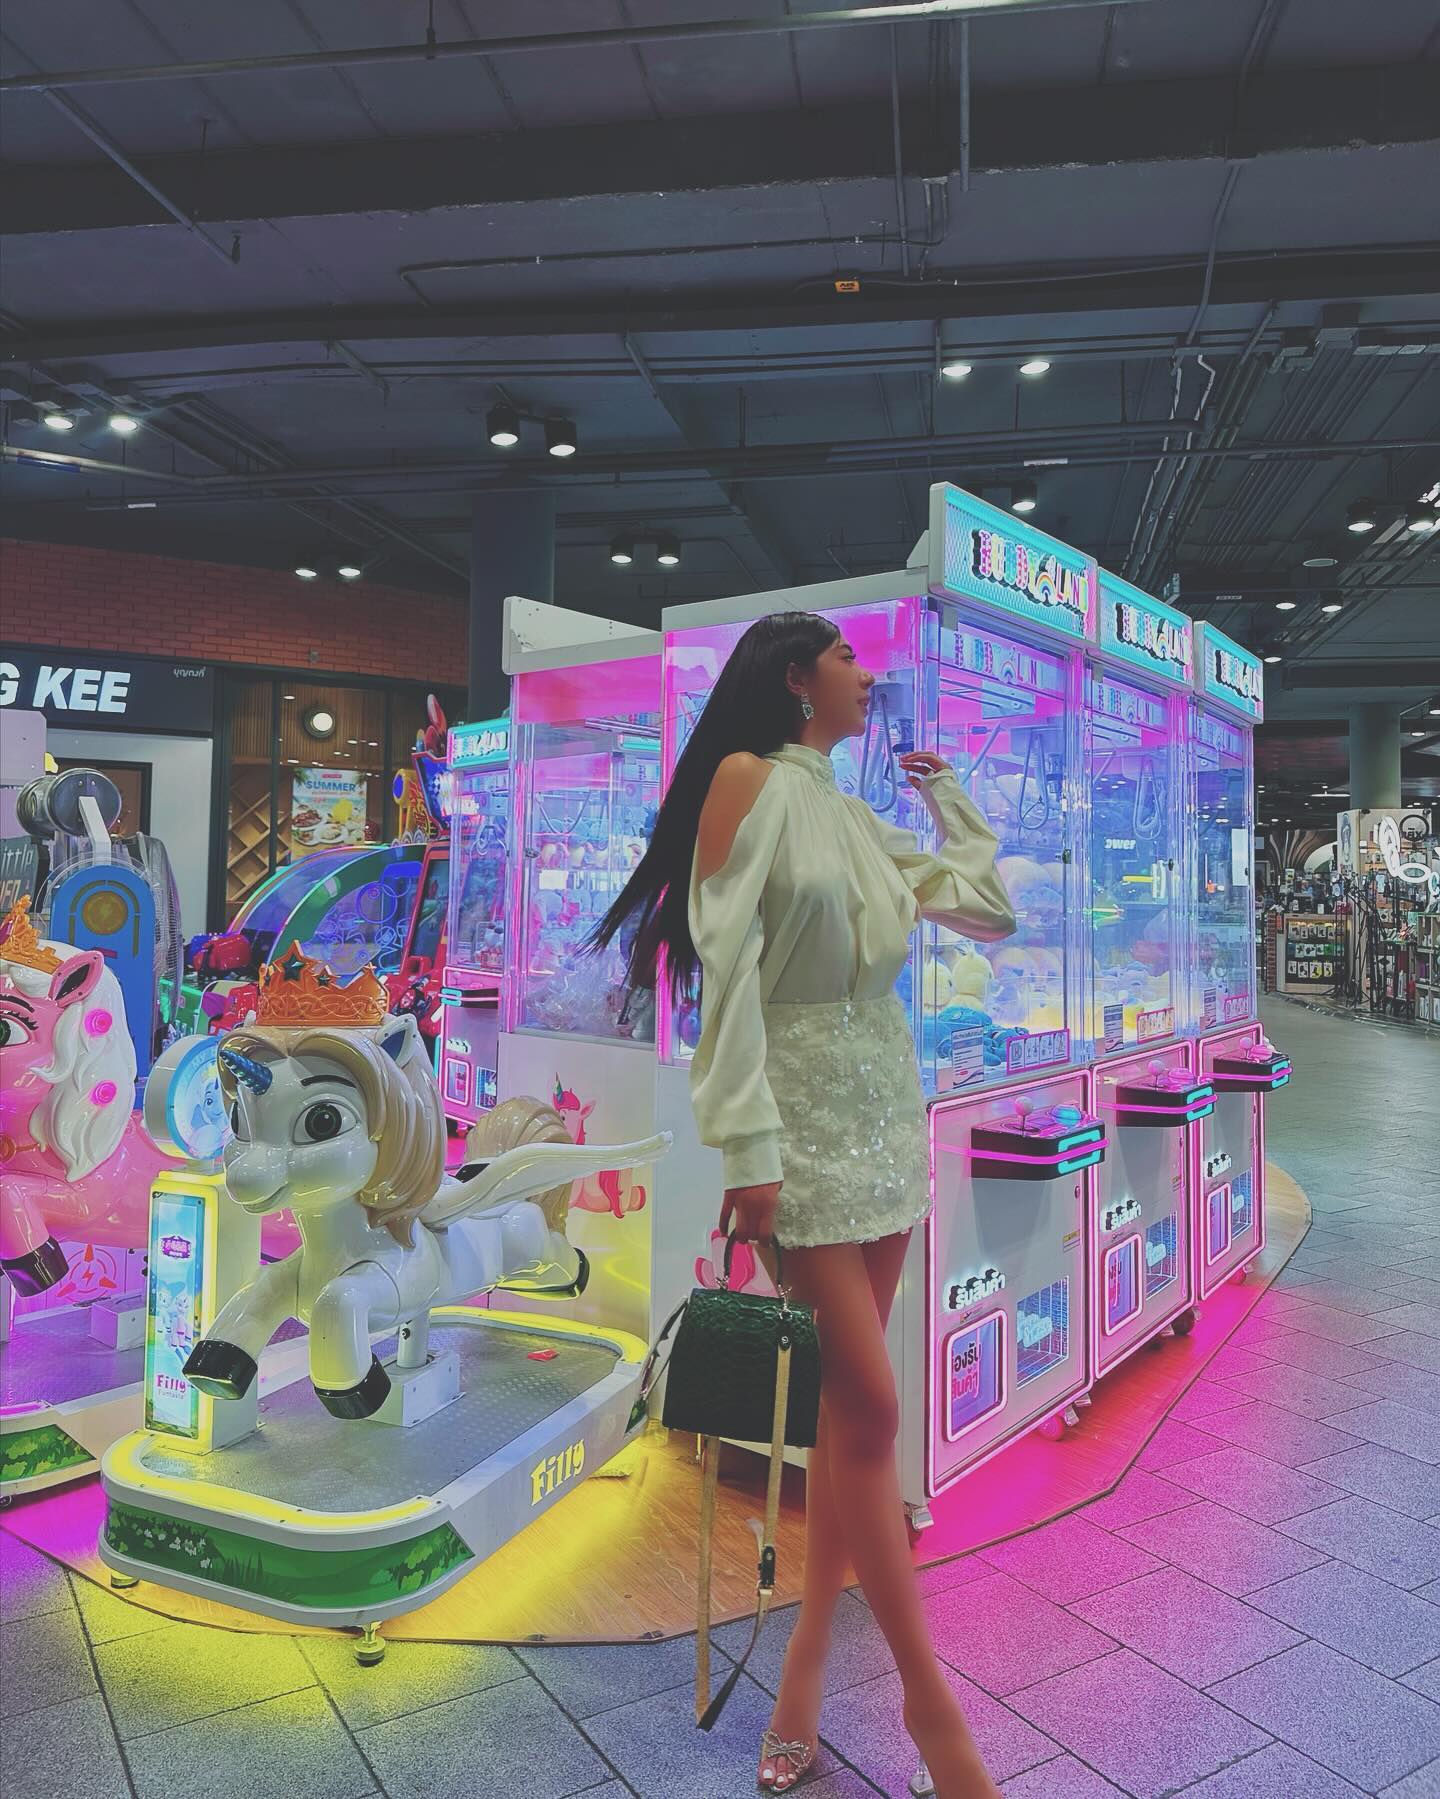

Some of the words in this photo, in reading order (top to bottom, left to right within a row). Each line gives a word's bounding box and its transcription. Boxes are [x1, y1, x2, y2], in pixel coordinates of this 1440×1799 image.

[974, 530, 1038, 600] BUDDY
[1055, 563, 1088, 613] LAND
[32, 665, 131, 713] KEE
[305, 781, 357, 792] SUMMER
[157, 1374, 187, 1393] Filly
[530, 1438, 585, 1506] Filly
